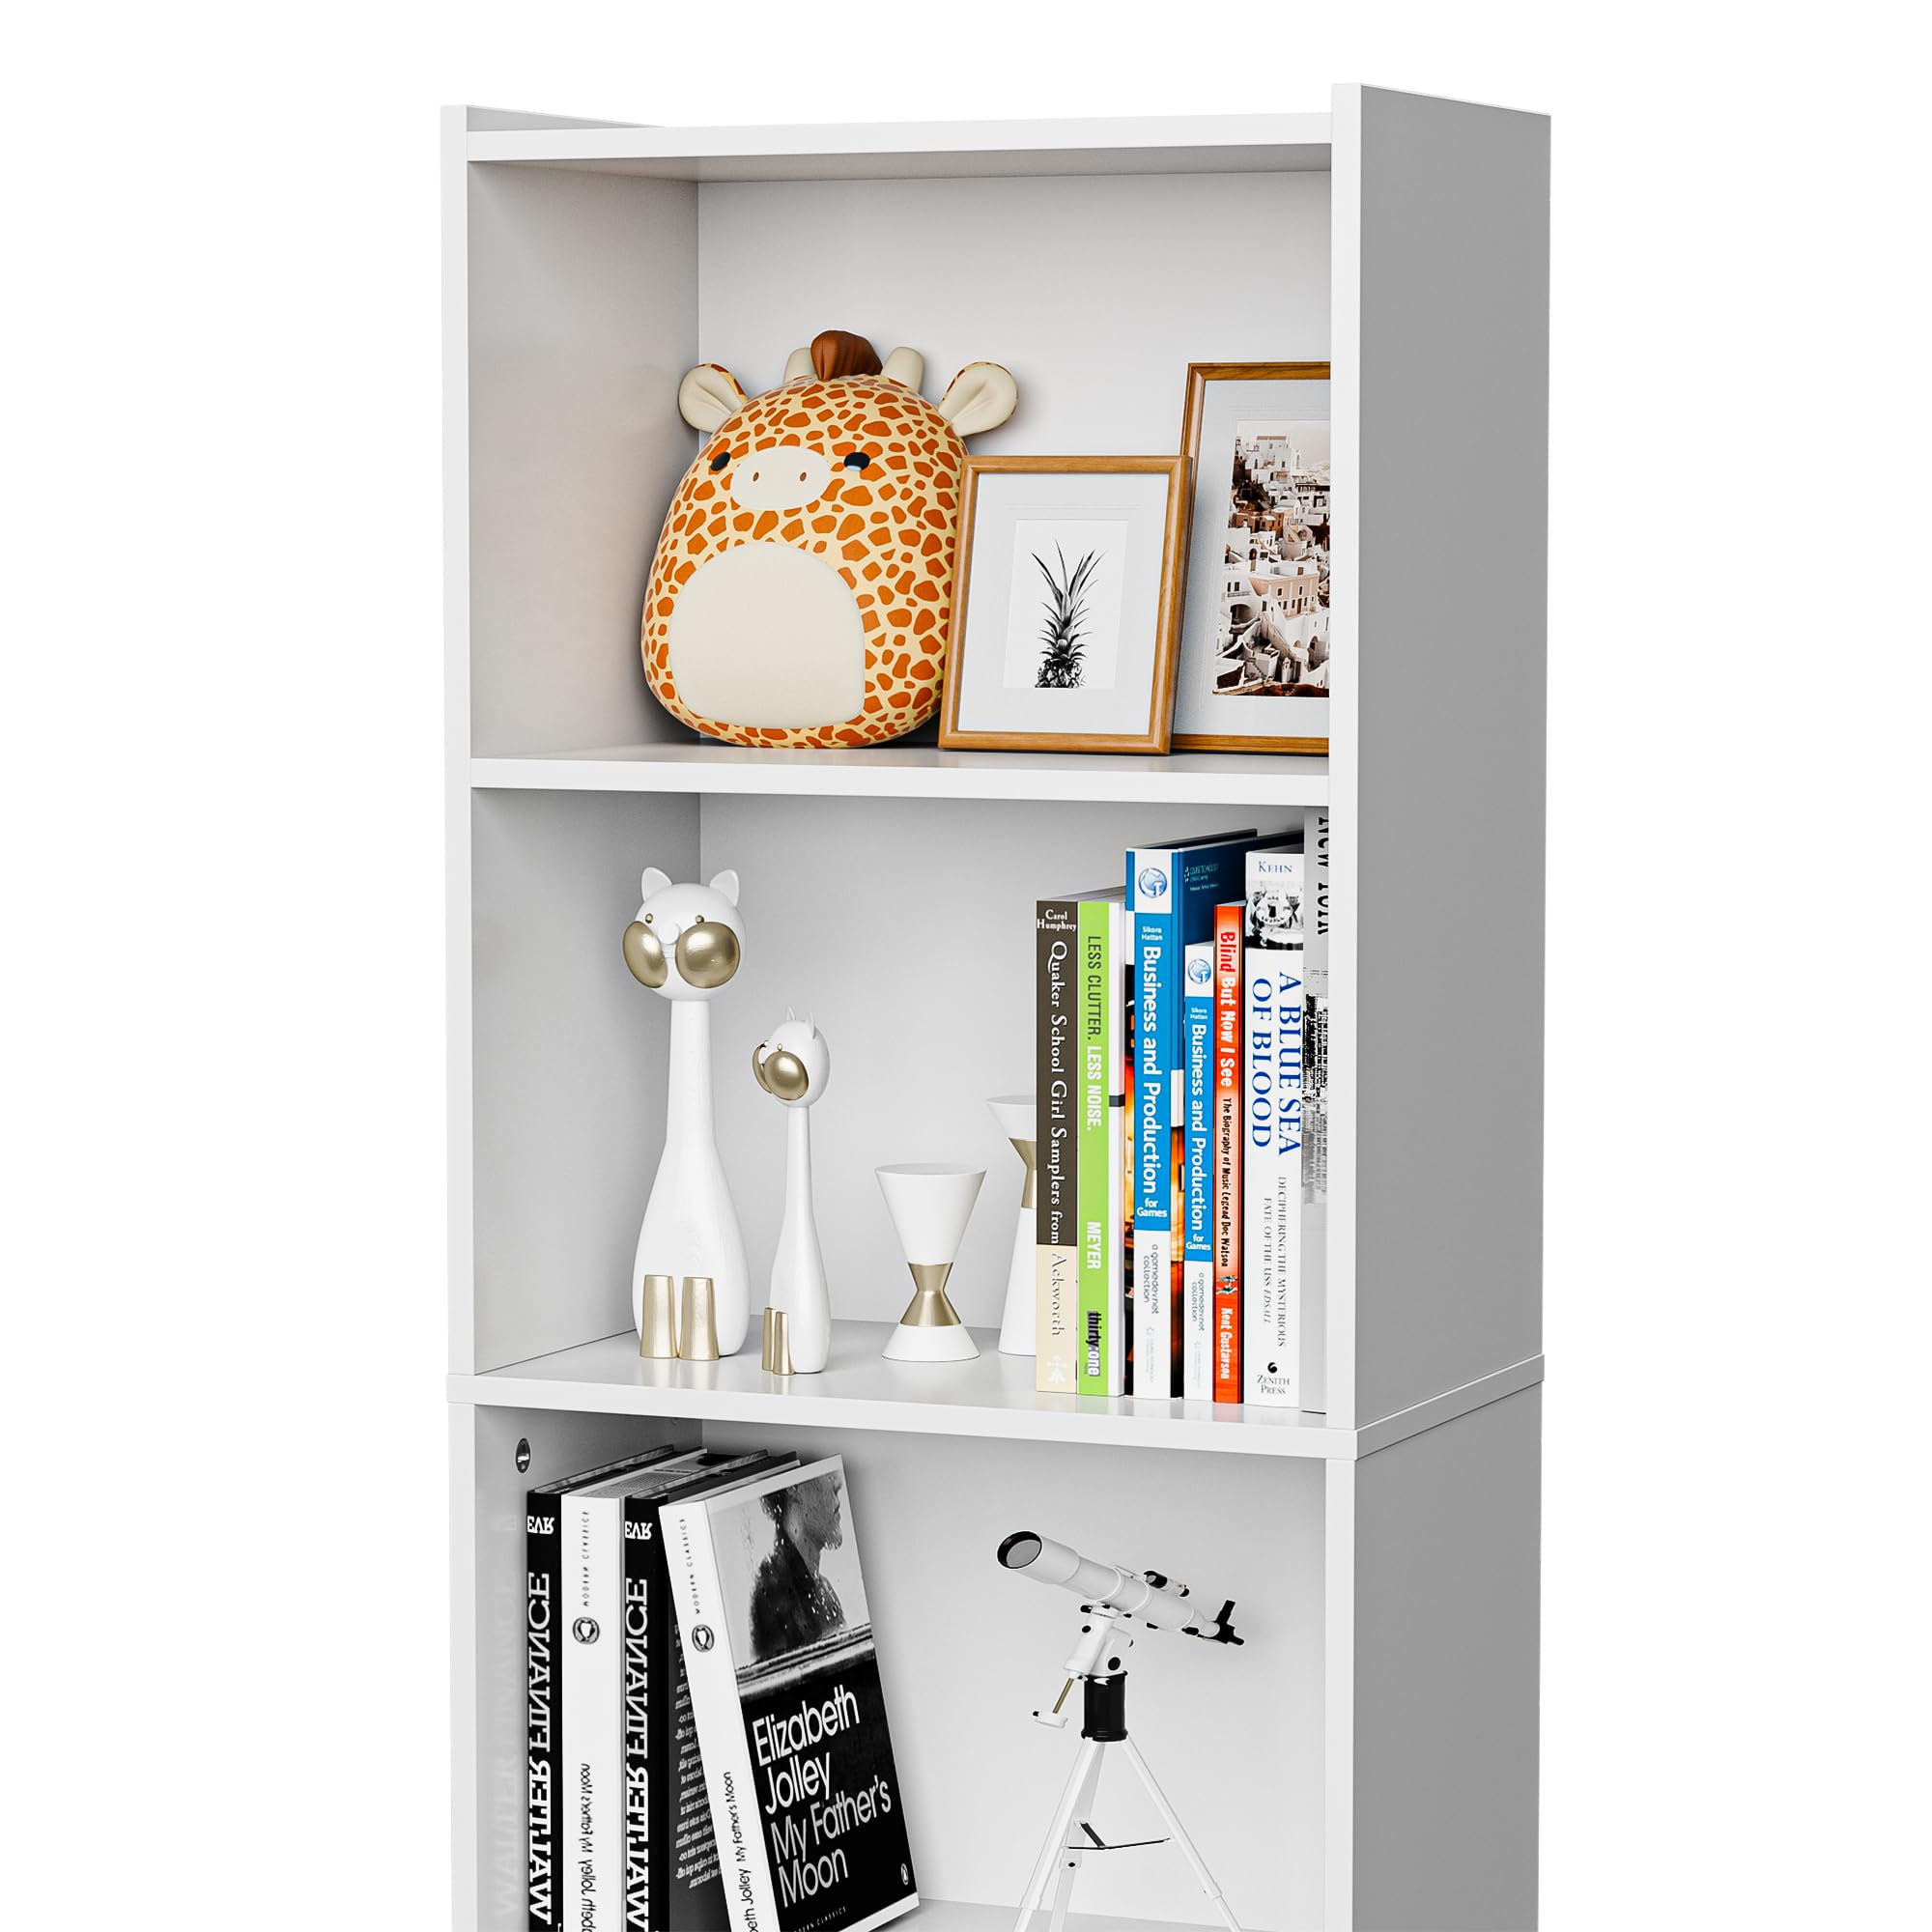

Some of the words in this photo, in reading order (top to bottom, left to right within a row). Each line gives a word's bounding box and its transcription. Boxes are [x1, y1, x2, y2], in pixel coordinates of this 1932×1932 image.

[1037, 919, 1077, 931] Humphrey
[1045, 909, 1067, 921] Carol
[1143, 925, 1162, 934] Sikora
[1088, 936, 1101, 969] LESS
[1219, 931, 1236, 973] Blind
[1047, 940, 1067, 1008] Quaker
[1143, 946, 1162, 1033] Business
[1279, 972, 1301, 993] A
[1088, 975, 1101, 1040] CLUTTER.
[1220, 977, 1236, 1007] But
[1252, 978, 1272, 1021] OF
[1051, 1014, 1067, 1073] School
[1220, 1011, 1236, 1043] Now
[1087, 1046, 1102, 1080] LESS
[1143, 1037, 1162, 1075] and
[1191, 1024, 1207, 1095] Business
[1279, 1005, 1301, 1089] BLUE
[1220, 1058, 1236, 1087] See
[1051, 1080, 1067, 1119] Girl
[1222, 1098, 1232, 1114] The
[1252, 1032, 1272, 1148] BLOOD
[1087, 1085, 1102, 1131] NOISE.
[1191, 1101, 1208, 1132] and
[1143, 1082, 1162, 1193] Production
[1221, 1115, 1232, 1155] Biography
[1279, 1098, 1301, 1155] SEA
[1047, 1126, 1067, 1206] Samplers
[1221, 1157, 1232, 1166] of
[1191, 1137, 1208, 1230] Production
[1221, 1168, 1232, 1190] Music
[1137, 1207, 1167, 1218] Games
[1145, 1198, 1158, 1208] for
[1221, 1192, 1232, 1219] Legend
[1264, 1198, 1272, 1223] FATE
[1277, 1177, 1287, 1252] DECIPHERING
[1050, 1210, 1064, 1244] from
[1193, 1234, 1204, 1242] for
[1221, 1221, 1232, 1236] Doc
[1264, 1226, 1272, 1241] OF
[1087, 1221, 1101, 1269] MEYER
[1186, 1241, 1211, 1251] Games
[1220, 1237, 1231, 1267] Watson
[1264, 1244, 1272, 1264] THE
[1277, 1254, 1287, 1274] THE
[1051, 1253, 1066, 1336] Ackworth
[1220, 1308, 1234, 1329] Kent
[1277, 1278, 1287, 1347] MYSTERIOUS
[1220, 1332, 1234, 1379] Gustavson
[752, 1684, 860, 1767] Elizabeth
[723, 1772, 736, 1803] Moon
[765, 1752, 830, 1815] Jolley
[770, 1814, 807, 1864] My
[810, 1775, 892, 1846] Father's
[736, 1846, 748, 1862] My
[738, 1868, 754, 1905] Jolley
[778, 1848, 848, 1908] Moon
